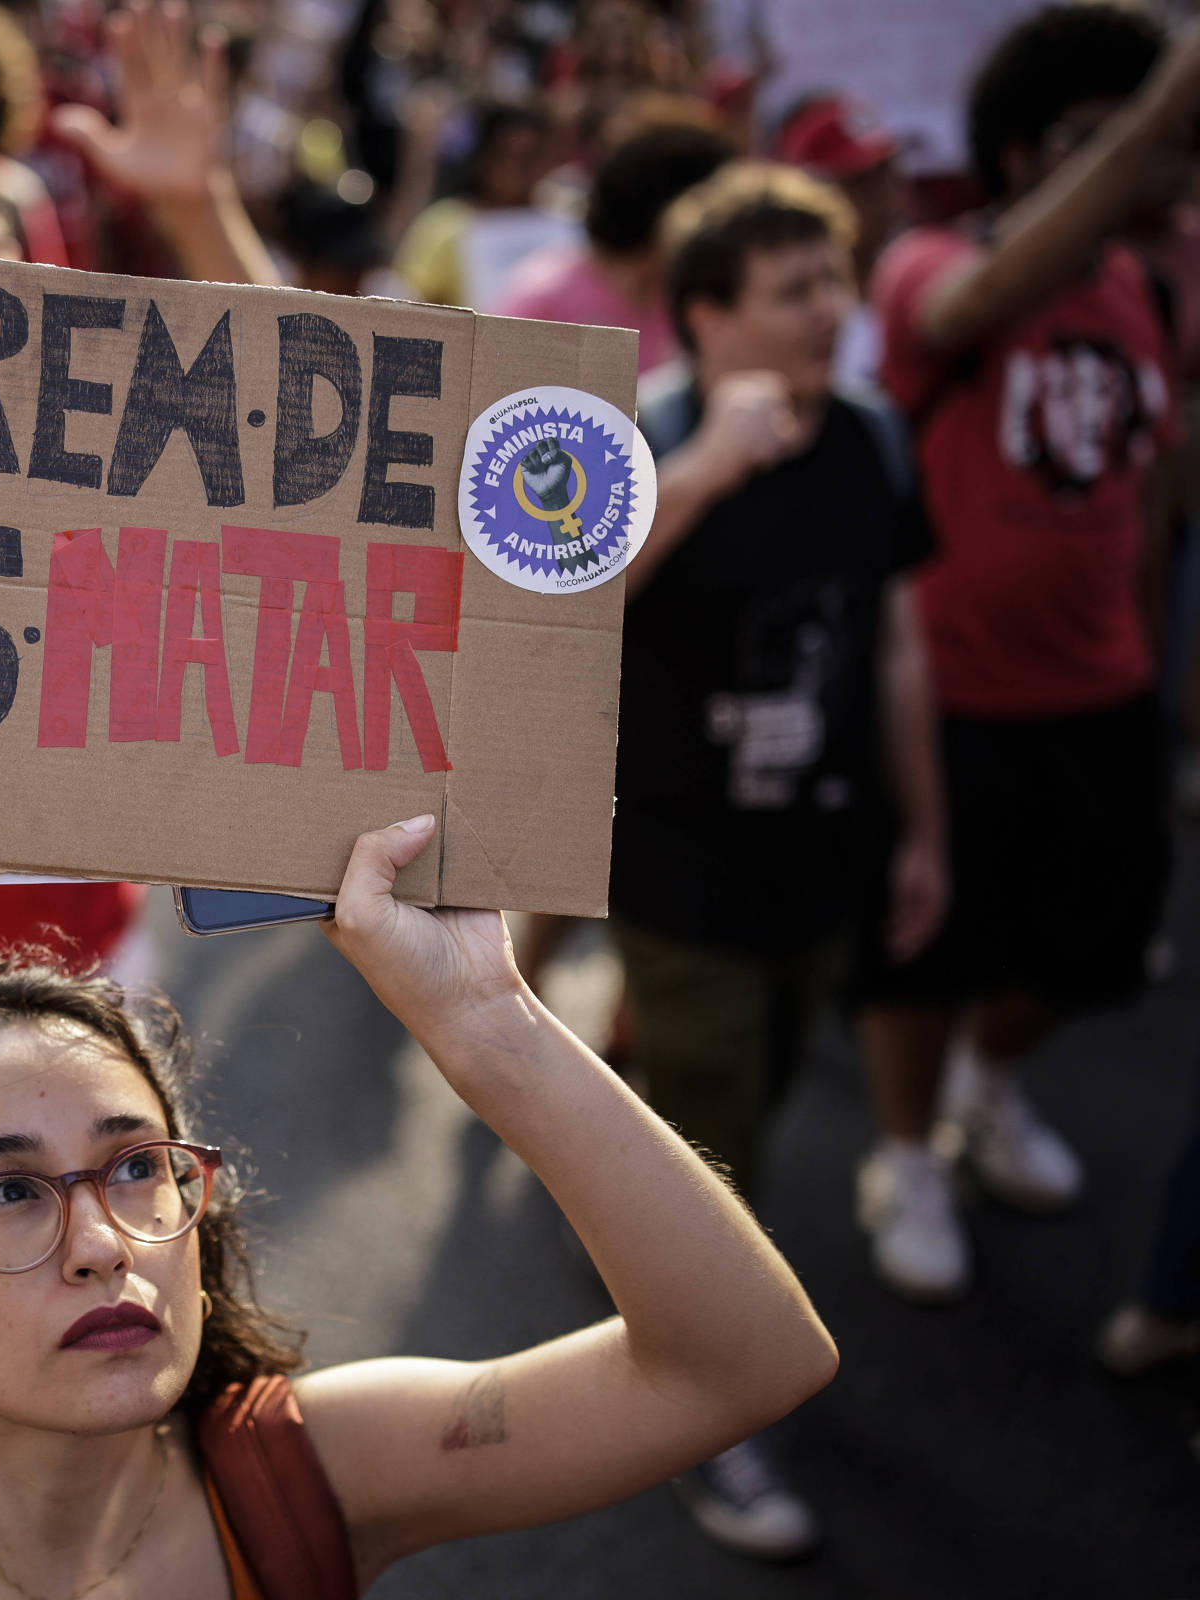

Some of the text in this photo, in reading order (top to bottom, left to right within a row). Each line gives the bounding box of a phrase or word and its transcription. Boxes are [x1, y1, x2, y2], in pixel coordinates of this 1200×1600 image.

[272, 311, 445, 530] DE
[489, 396, 538, 424] @LUANAPSOL
[484, 421, 584, 488] FEMINISTA
[502, 480, 625, 560] ANTIRRACISTA
[555, 541, 634, 588] TOCOMLUANA.COM.BR
[36, 525, 466, 773] MATAR
